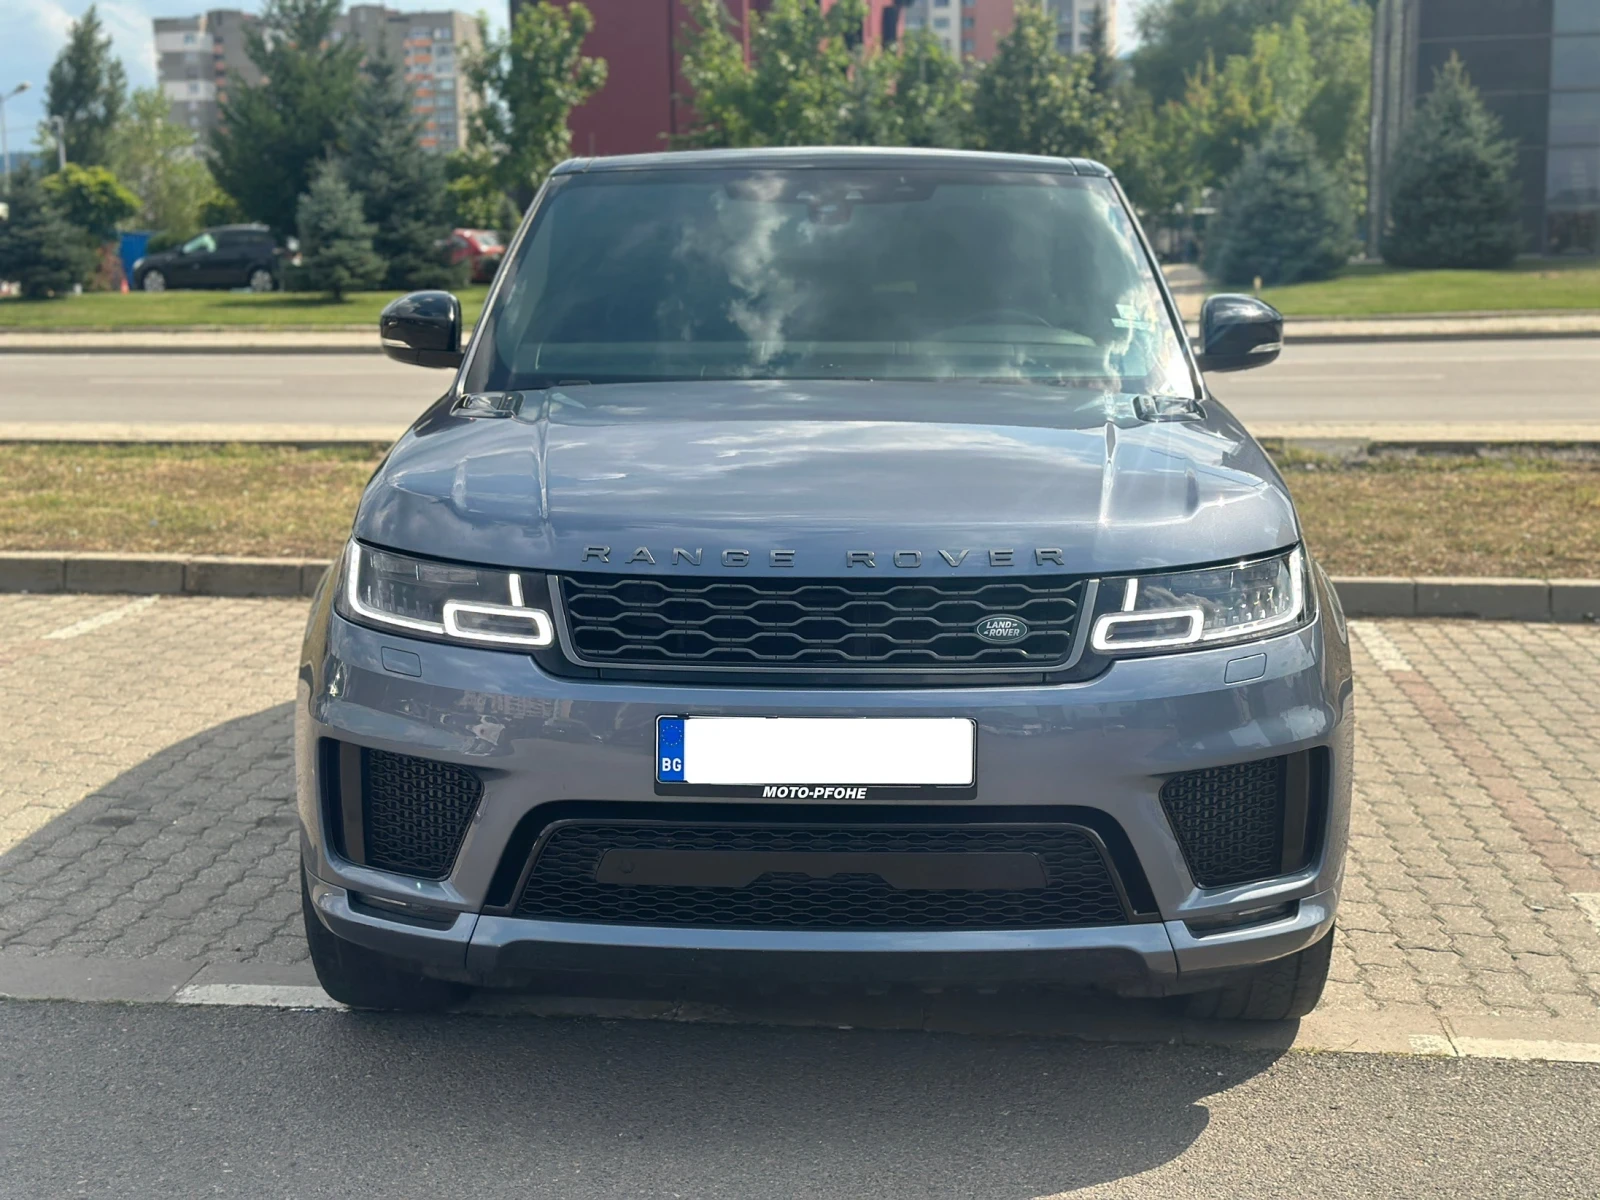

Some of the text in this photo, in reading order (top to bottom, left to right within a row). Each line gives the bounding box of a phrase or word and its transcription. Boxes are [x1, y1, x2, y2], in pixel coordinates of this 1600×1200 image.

[581, 544, 1065, 568] RANGE ROVER
[662, 757, 682, 772] BG
[762, 786, 867, 799] MOTO-PFOHE
